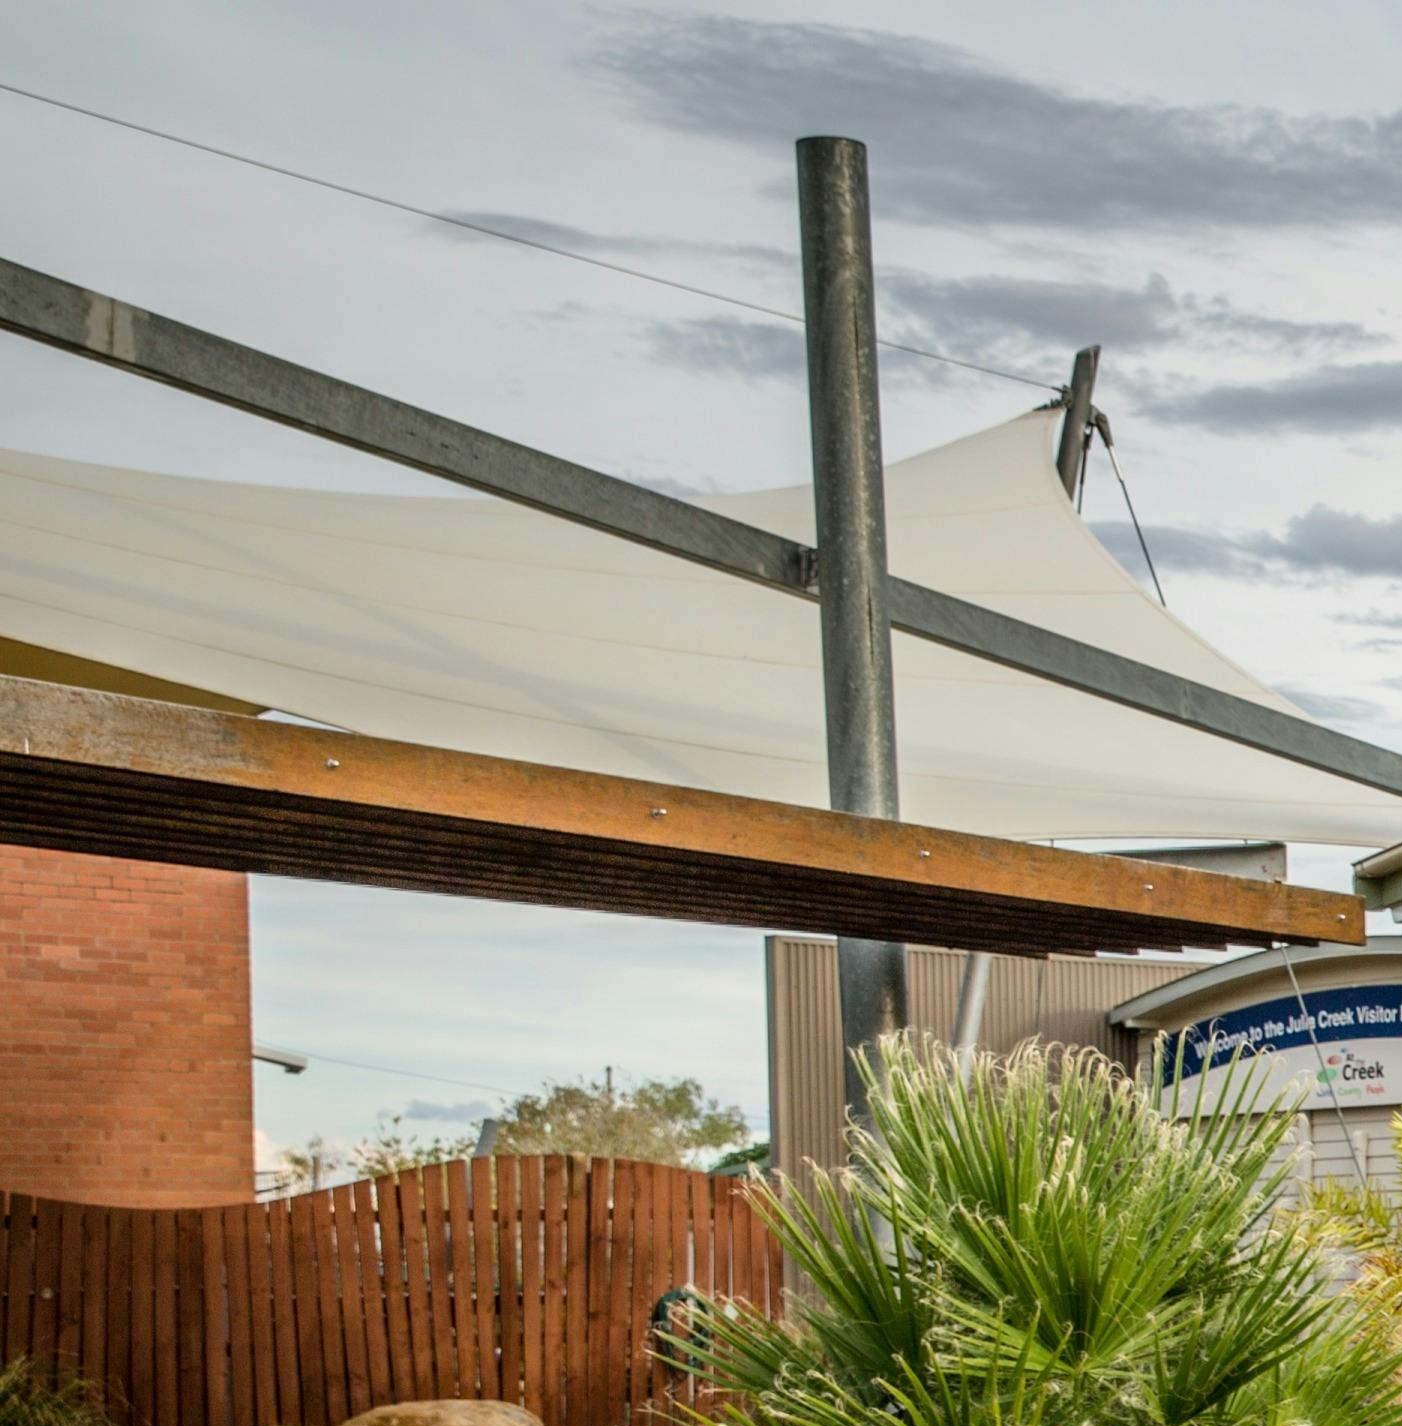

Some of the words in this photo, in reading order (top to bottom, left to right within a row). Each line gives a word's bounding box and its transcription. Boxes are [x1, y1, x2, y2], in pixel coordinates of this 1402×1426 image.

[1249, 1026, 1263, 1042] to
[1264, 1020, 1284, 1039] the
[1318, 1007, 1354, 1029] Creek
[1356, 1005, 1397, 1024] Visitor
[1343, 1061, 1384, 1080] Creek
